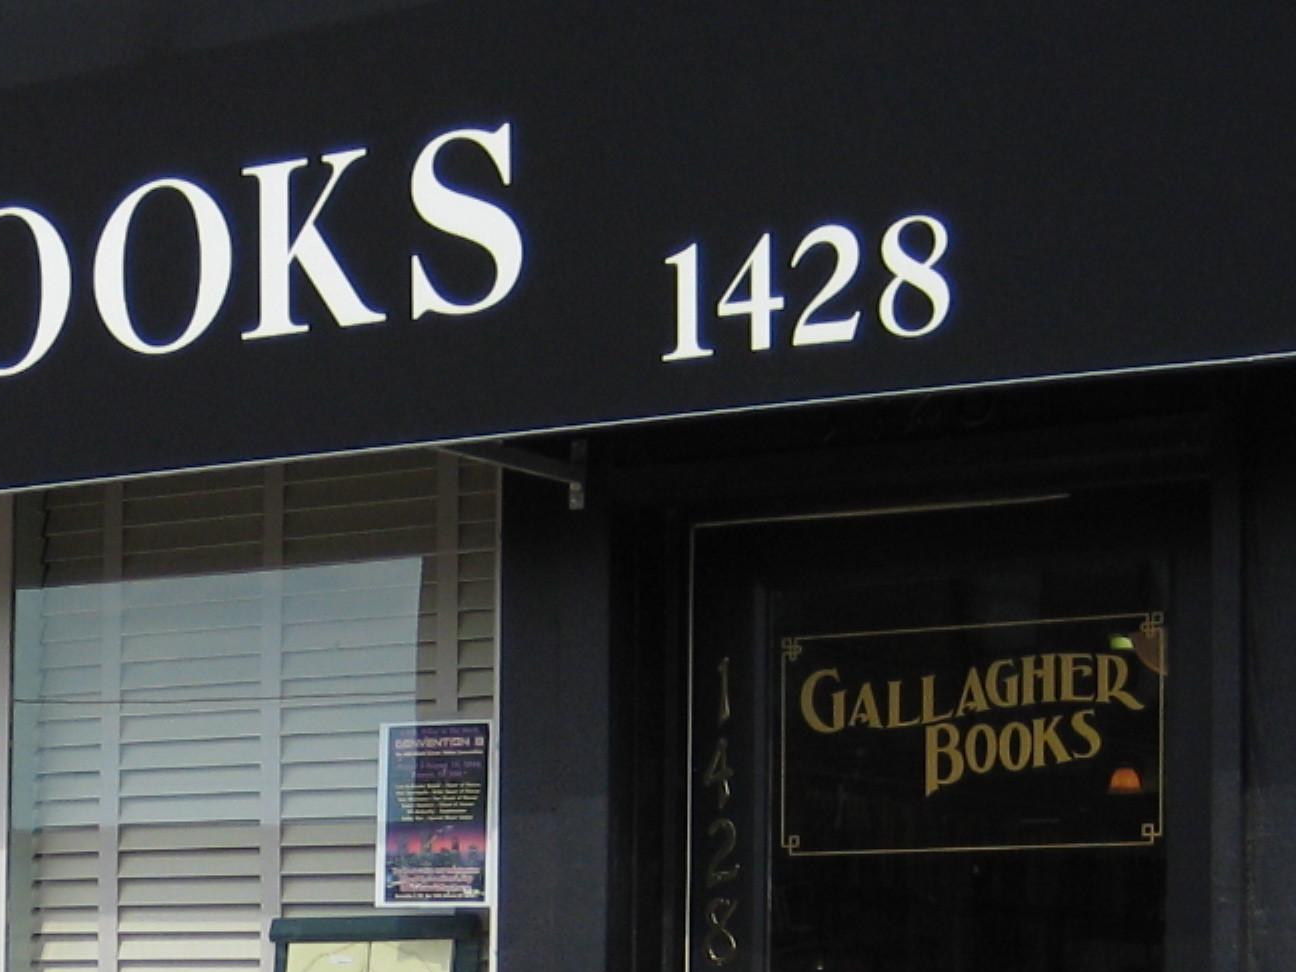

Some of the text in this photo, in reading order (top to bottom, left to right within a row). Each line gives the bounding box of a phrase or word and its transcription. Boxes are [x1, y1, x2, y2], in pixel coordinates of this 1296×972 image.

[662, 215, 952, 364] 1428
[800, 652, 1145, 734] GALLAGHER
[706, 656, 740, 966] 1428
[924, 709, 1102, 797] BOOKS
